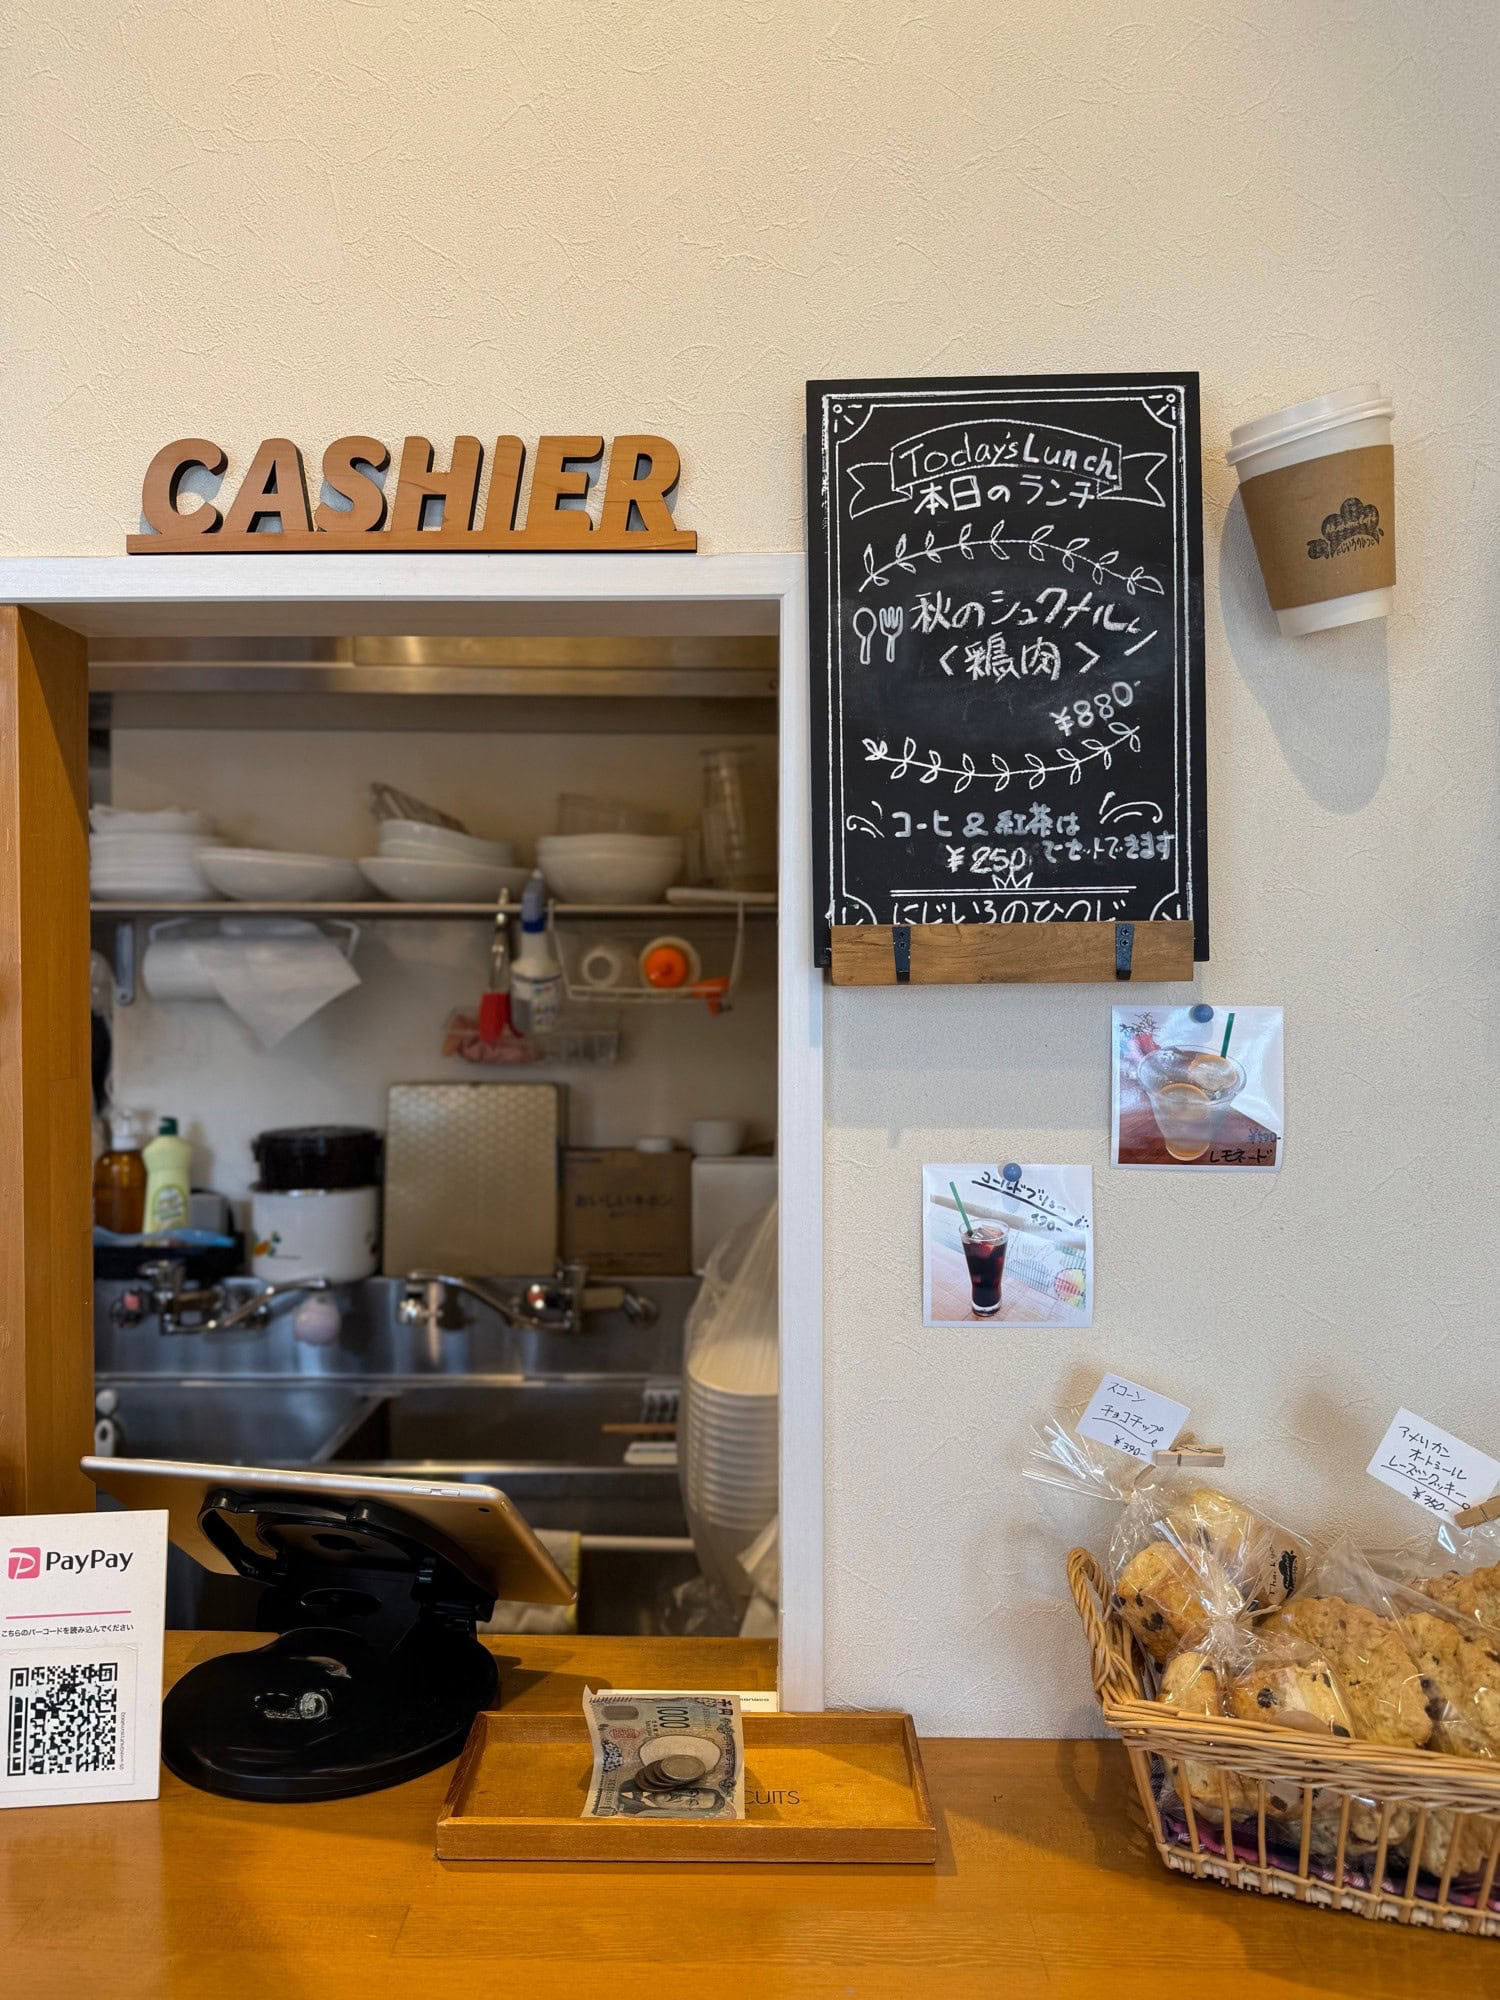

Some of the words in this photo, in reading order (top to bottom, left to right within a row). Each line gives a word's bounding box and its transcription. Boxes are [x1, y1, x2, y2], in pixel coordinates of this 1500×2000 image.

[899, 432, 1019, 478] Today's
[1022, 432, 1118, 480] Lunch
[141, 435, 681, 534] CASHIER
[913, 474, 1095, 516] 本日のランチ
[1210, 1148, 1273, 1163] レモネード
[1107, 1381, 1147, 1402] スコーン
[1100, 1404, 1164, 1435] チョコチップ
[1398, 1425, 1450, 1458] アメリカン
[1388, 1455, 1467, 1498] レーズンクッキー
[1408, 1448, 1467, 1480] オートミール
[46, 1549, 133, 1575] PayPay
[1, 1623, 134, 1638] こちらのバーコードを読み込んでください
[655, 1706, 690, 1729] 1000
